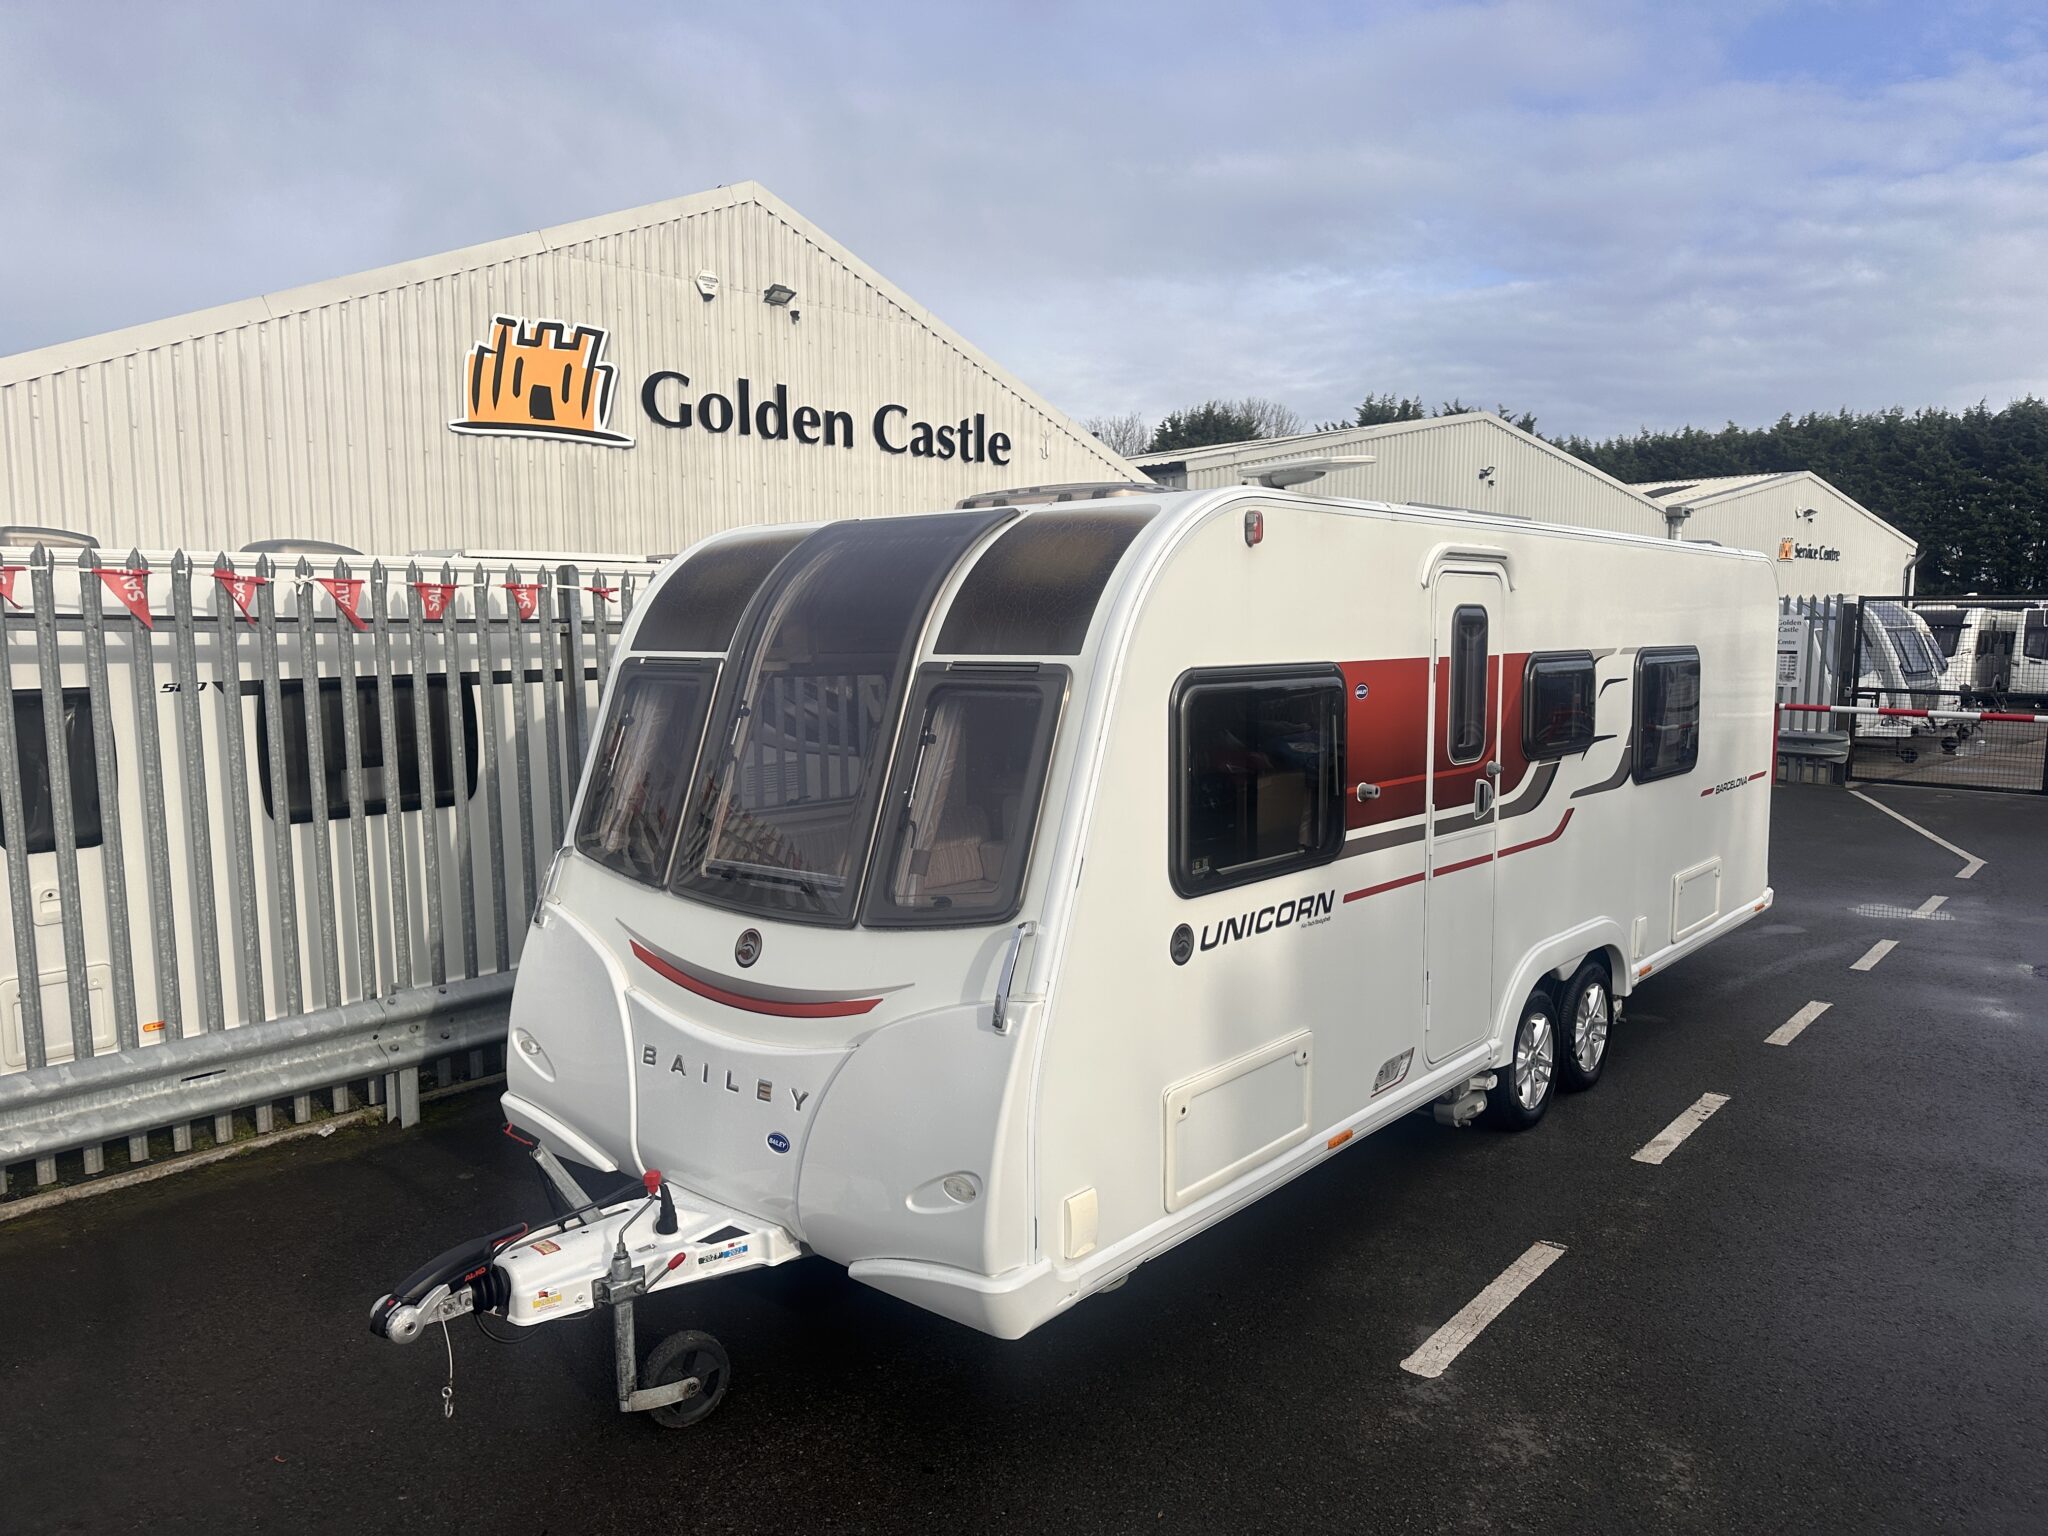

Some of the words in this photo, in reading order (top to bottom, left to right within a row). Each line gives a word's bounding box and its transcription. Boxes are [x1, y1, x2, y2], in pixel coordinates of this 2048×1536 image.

[641, 371, 853, 448] Golden
[873, 404, 1011, 466] Castle
[1795, 543, 1818, 560] Service
[1819, 545, 1840, 561] Centre
[233, 575, 248, 603] SA
[335, 582, 351, 610] AL
[428, 584, 443, 612] SAL
[516, 584, 531, 609] SAL
[1715, 776, 1748, 795] BARCELONA
[1200, 889, 1336, 951] UNICORN
[642, 1044, 809, 1111] BAILEY
[769, 1137, 787, 1148] BAILEY
